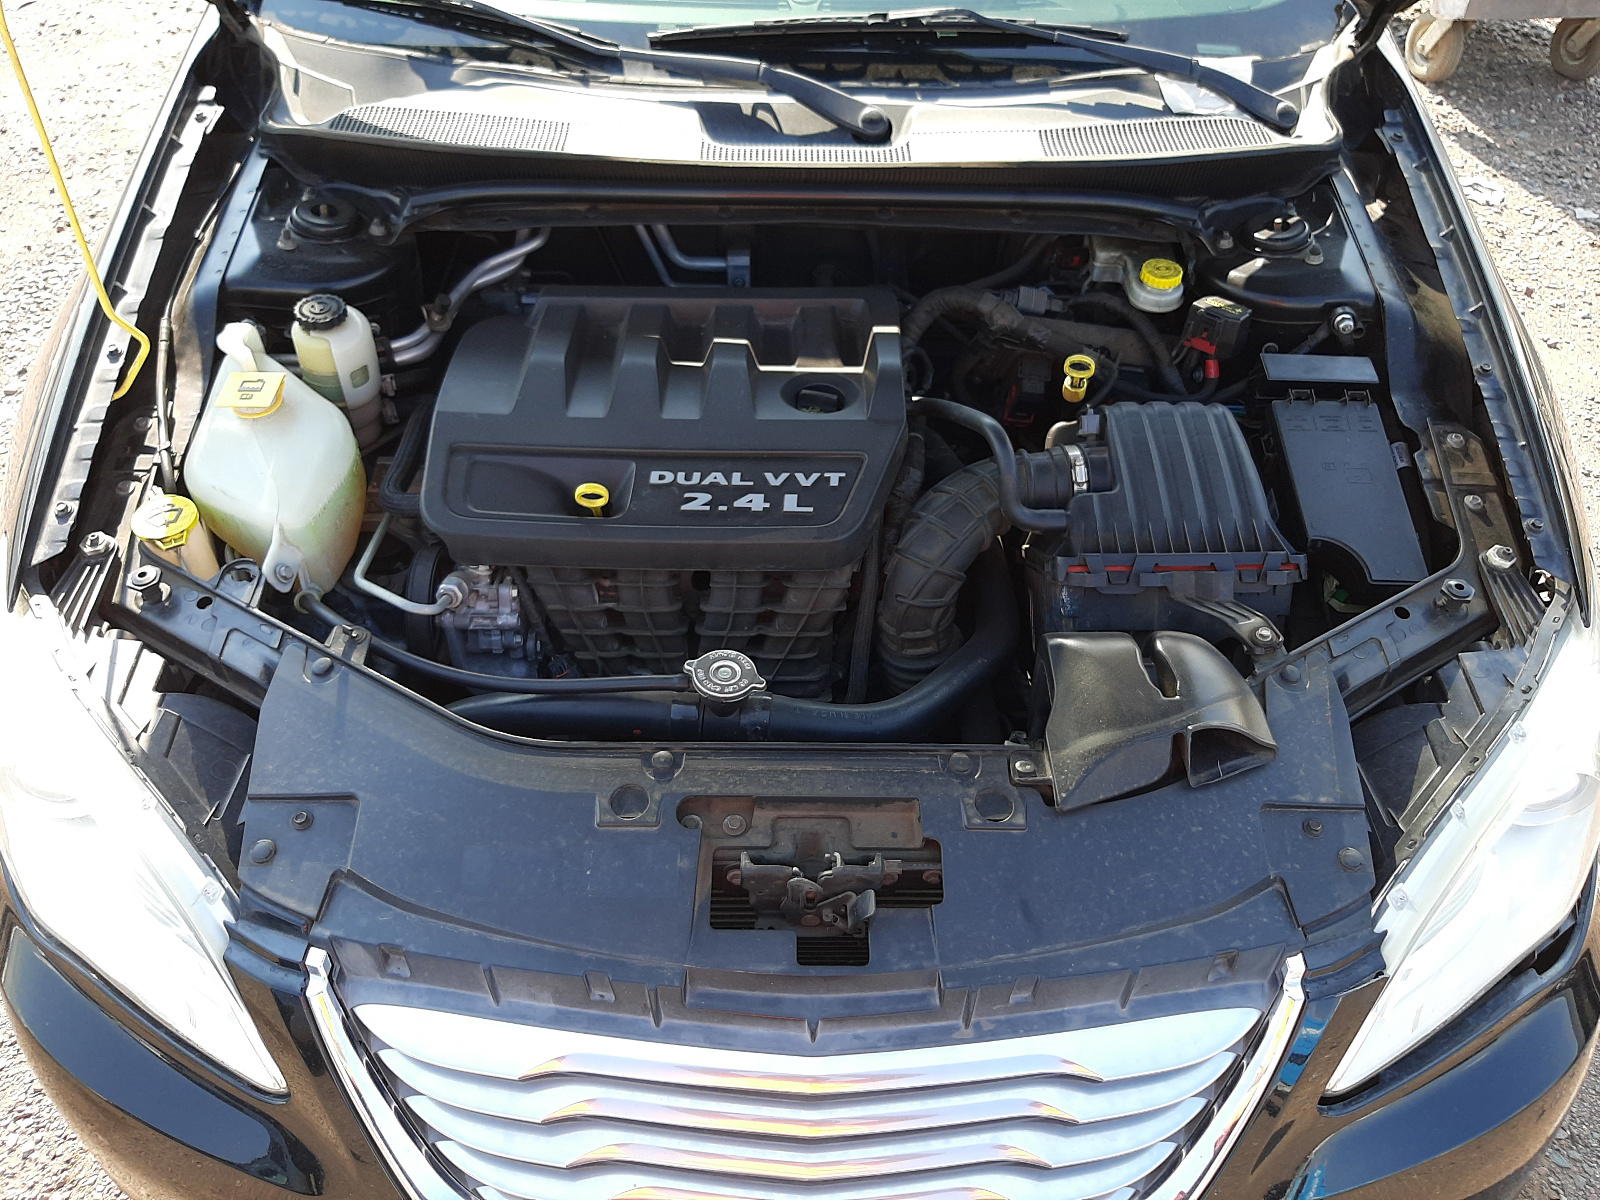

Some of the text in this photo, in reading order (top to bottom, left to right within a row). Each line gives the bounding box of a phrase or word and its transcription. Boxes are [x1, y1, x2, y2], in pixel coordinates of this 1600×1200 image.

[649, 470, 846, 487] DUAL VVT
[680, 492, 814, 512] 2.4 L
